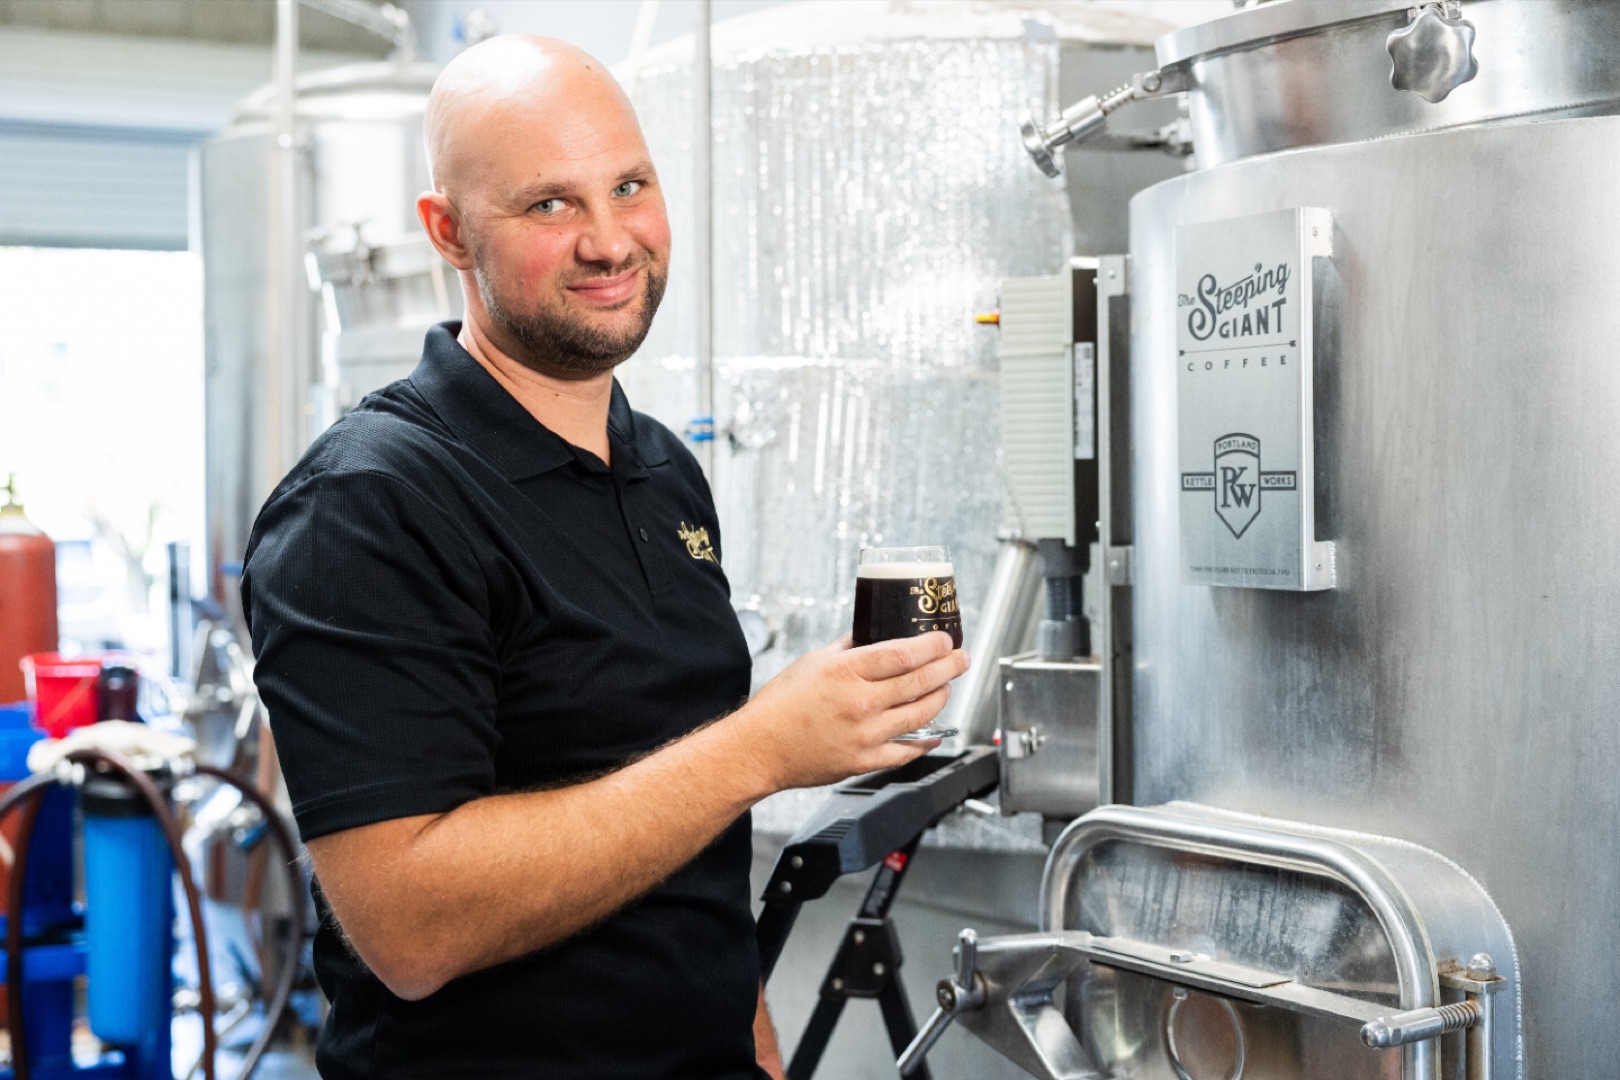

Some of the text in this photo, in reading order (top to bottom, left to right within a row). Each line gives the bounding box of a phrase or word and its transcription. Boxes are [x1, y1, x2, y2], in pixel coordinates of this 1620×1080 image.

[1177, 262, 1291, 341] The Steeping
[1218, 297, 1287, 339] GIANT
[1187, 355, 1287, 372] COFFEE
[1217, 439, 1257, 450] PORTLAND
[1185, 475, 1292, 487] KETTLE WORKS
